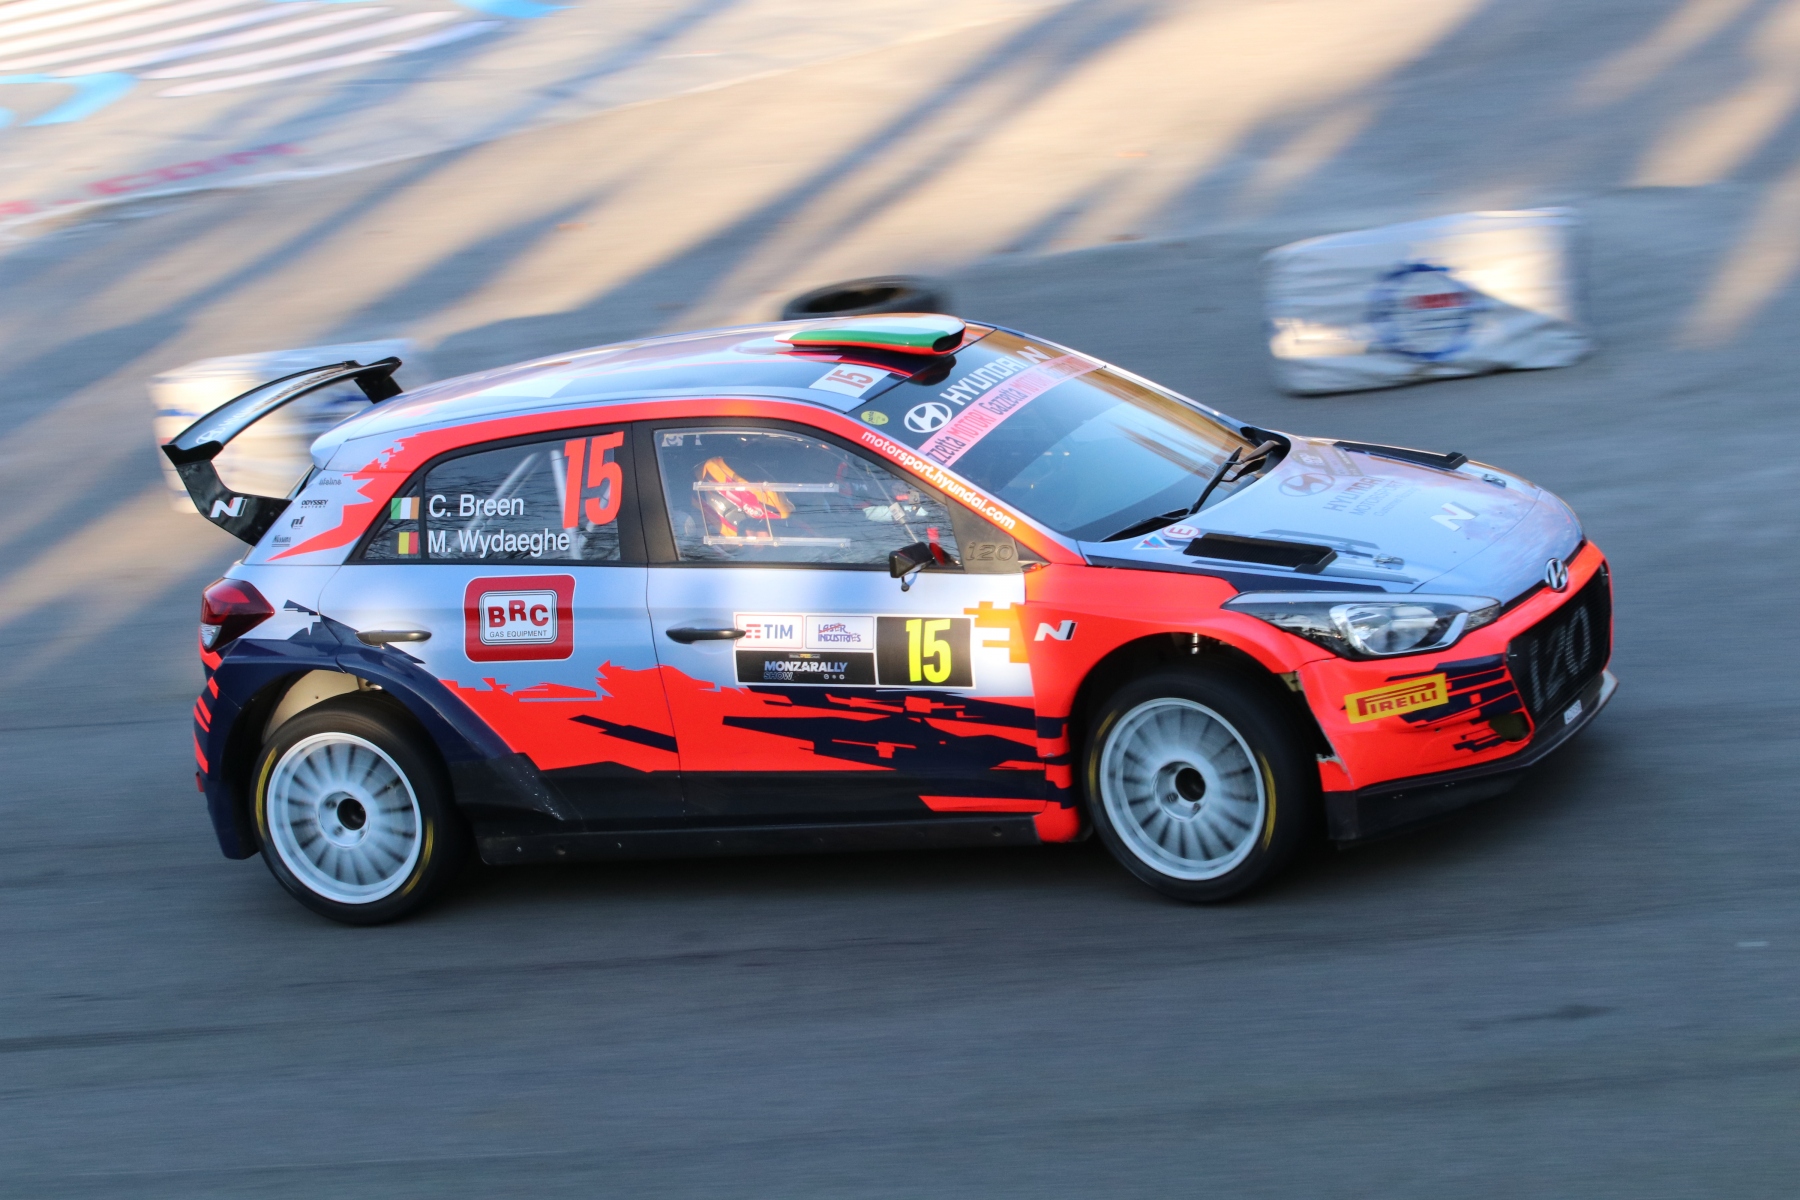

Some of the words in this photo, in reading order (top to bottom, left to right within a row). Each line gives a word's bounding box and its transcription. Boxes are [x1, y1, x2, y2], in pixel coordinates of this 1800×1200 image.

[825, 370, 874, 389] 15
[939, 355, 1029, 406] HYUNDAI
[946, 408, 998, 442] MOTORI
[978, 387, 1029, 415] Gazzetta
[562, 431, 624, 529] 15
[861, 431, 1016, 530] motorsport.hyundai.com
[428, 494, 452, 517] C.
[459, 494, 524, 517] Breen
[1323, 475, 1386, 512] HYUNDAI
[427, 530, 452, 553] M.
[458, 528, 570, 558] Wydaeghe
[965, 541, 1014, 561] i20
[487, 600, 549, 628] BRC
[506, 630, 548, 638] EQUIPMENT
[764, 624, 794, 639] TIM
[817, 633, 862, 643] INDUSTRIES
[818, 624, 847, 634] LASER
[905, 618, 952, 684] 15
[763, 671, 794, 680] SHOW
[764, 660, 848, 673] MONZARALLY
[1356, 681, 1437, 716] PIRELLI
